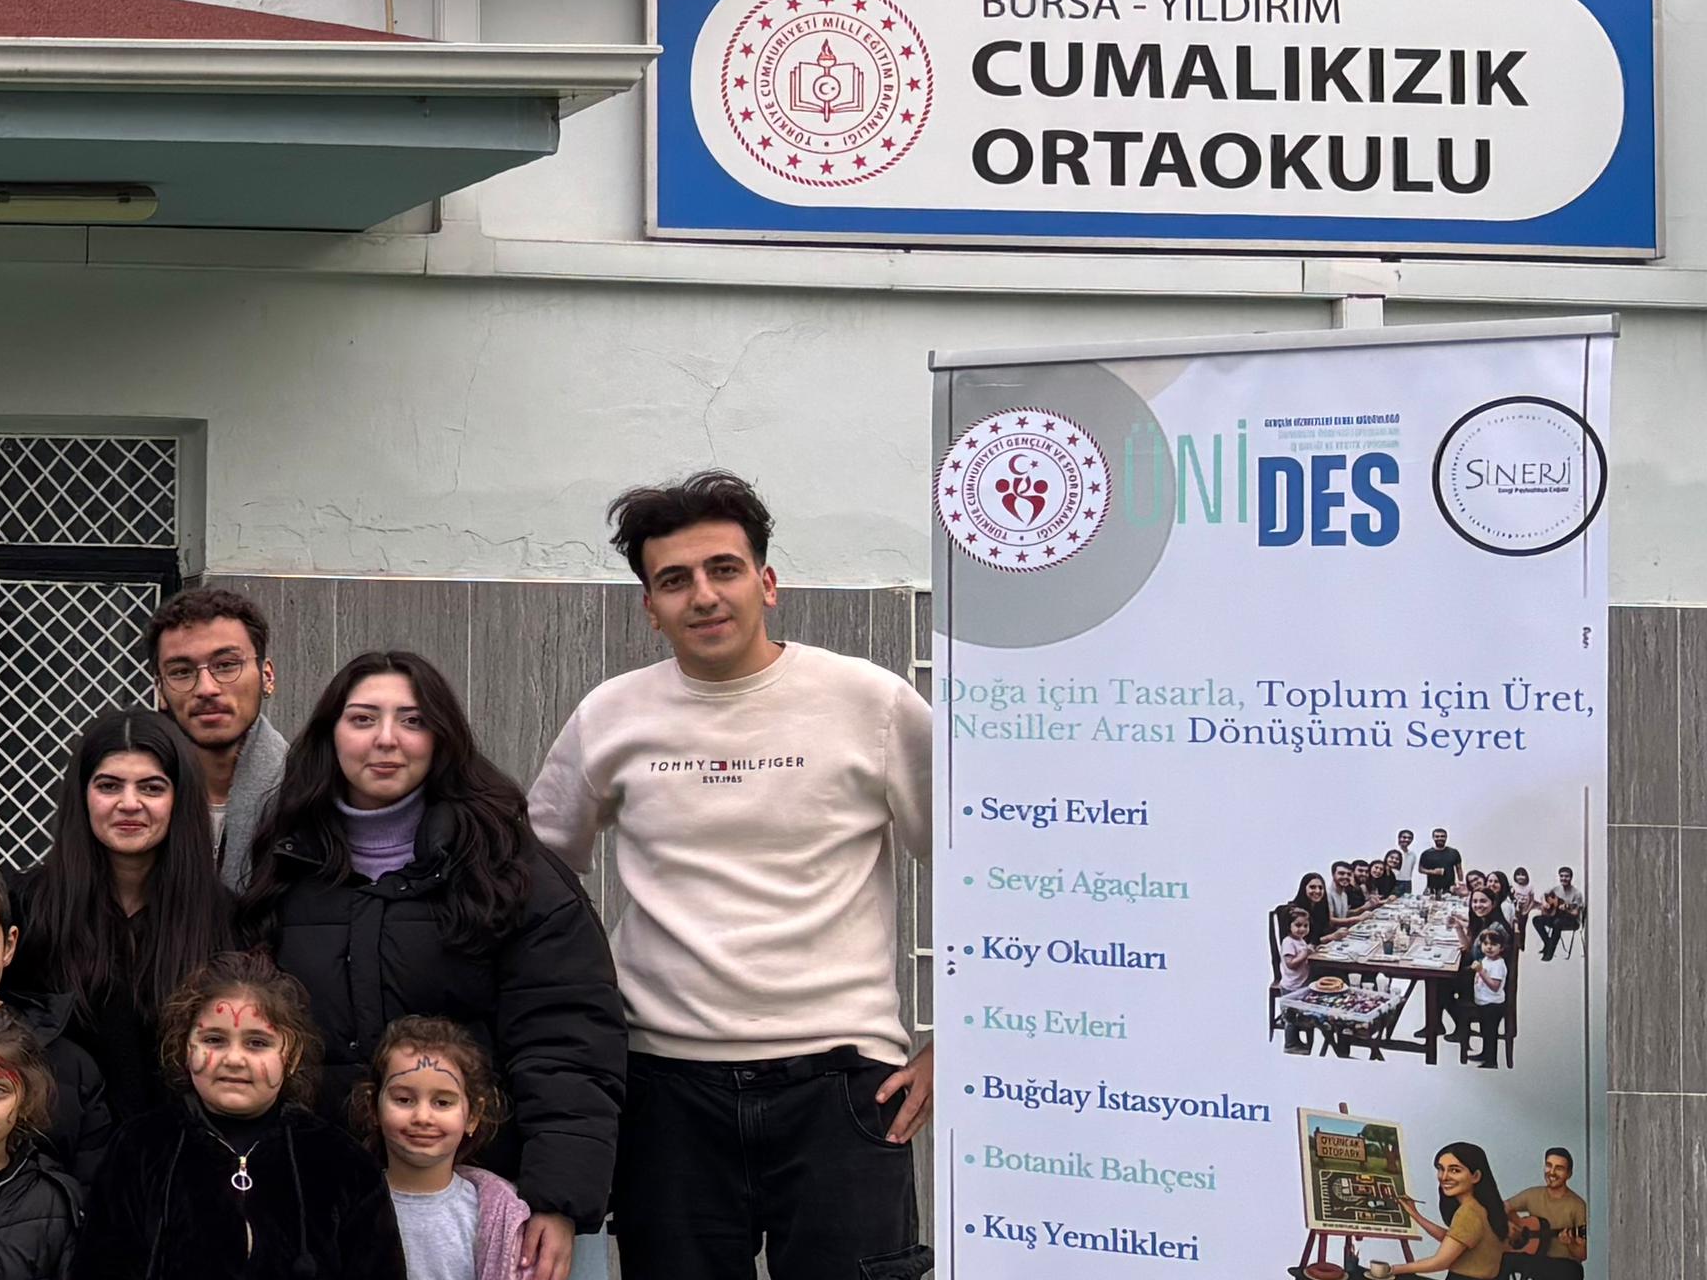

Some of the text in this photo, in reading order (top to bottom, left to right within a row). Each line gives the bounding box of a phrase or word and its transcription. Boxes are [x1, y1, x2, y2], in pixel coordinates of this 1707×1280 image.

[760, 17, 818, 97] CUMHURİYETİ
[822, 17, 863, 35] MİLLİ
[971, 39, 1530, 107] CUMALIKIZIK
[971, 129, 1493, 196] ORTAOKULU
[939, 677, 1594, 717] Doğa için Tasarla, Toplum için Üret,
[953, 713, 1527, 756] Nesiller Arası Dönüşümü Seyret
[650, 757, 805, 772] TOMMY HILFIGER
[981, 797, 1149, 829] Sevgi Evleri
[987, 867, 1190, 903] Sevgi Ağaçları
[982, 936, 1167, 970] Köy Okulları
[983, 1006, 1128, 1039] Kuş Evleri
[983, 1075, 1272, 1123] Buğday İstasyonları
[983, 1145, 1217, 1194] Botanik Bahçesi
[983, 1214, 1199, 1261] Kuş Yemlikleri
